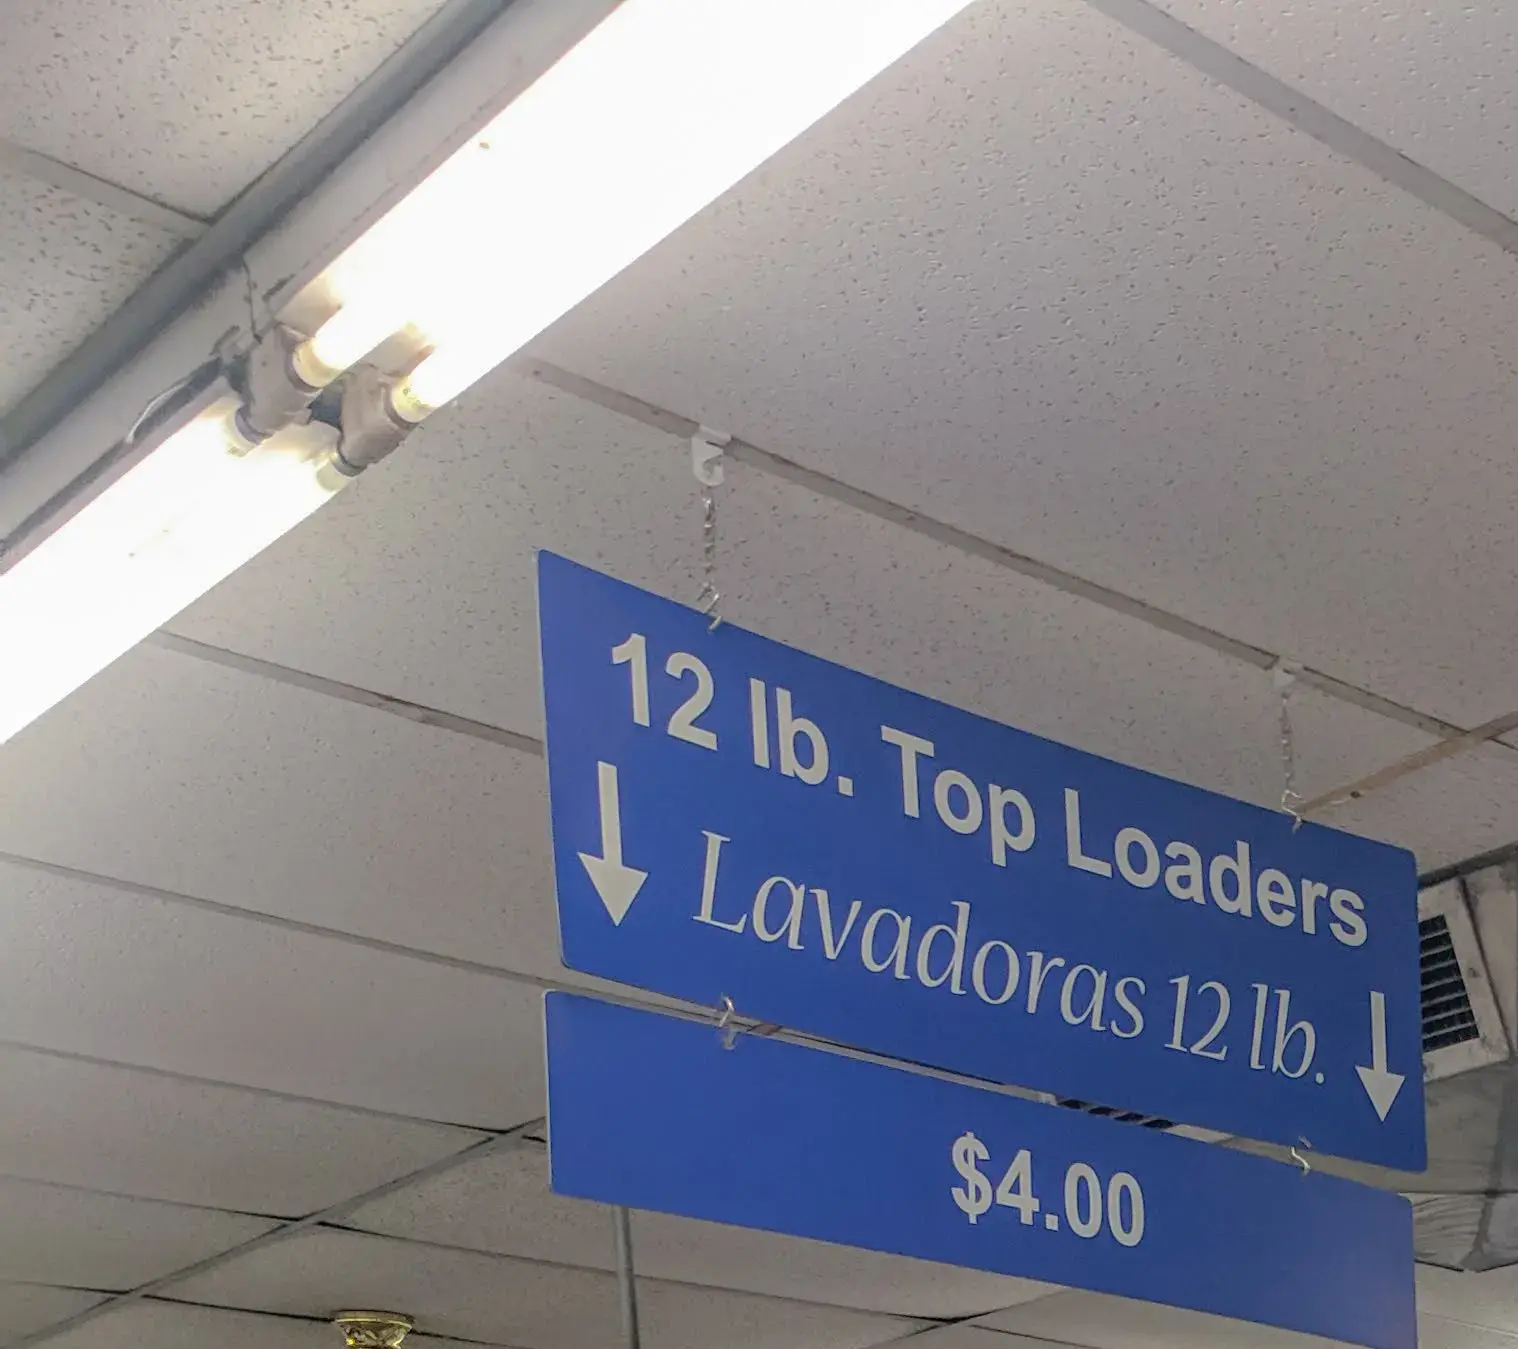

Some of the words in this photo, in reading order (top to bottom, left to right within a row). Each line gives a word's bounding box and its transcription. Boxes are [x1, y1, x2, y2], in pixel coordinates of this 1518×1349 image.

[611, 632, 718, 751] 12
[750, 678, 855, 797] lb.
[881, 725, 1036, 866] Top
[1065, 788, 1368, 947] Loaders
[692, 830, 1145, 1039] Lavadoras
[1165, 975, 1229, 1061] 12
[1249, 983, 1327, 1084] lb.
[951, 1132, 1145, 1247] $4.00
